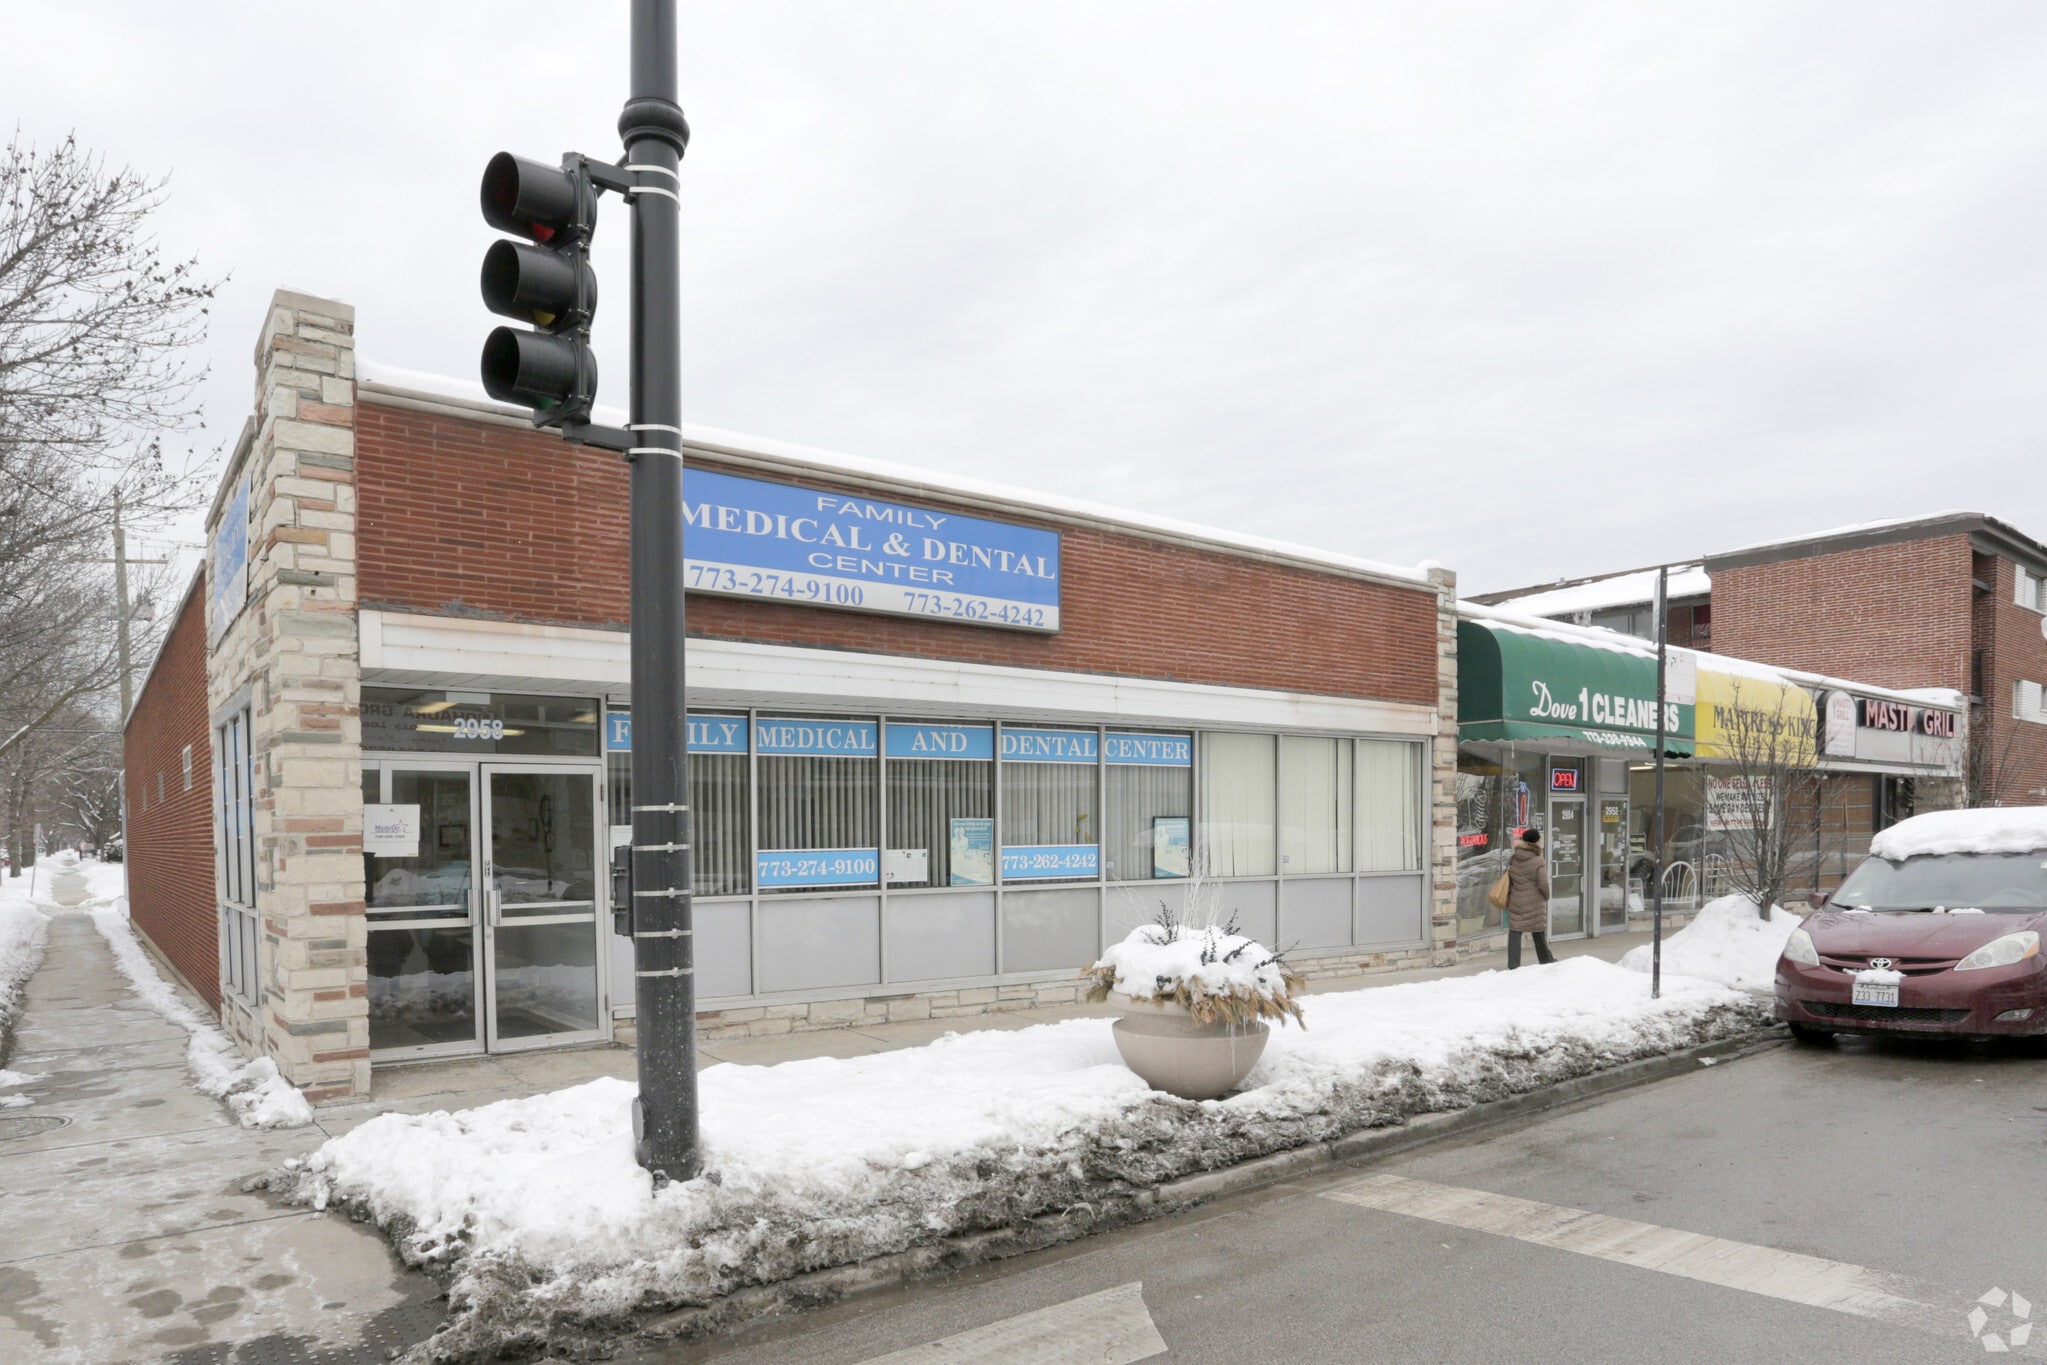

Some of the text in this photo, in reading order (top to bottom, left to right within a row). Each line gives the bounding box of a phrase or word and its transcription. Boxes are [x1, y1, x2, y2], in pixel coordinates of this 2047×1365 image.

[817, 497, 947, 531] FAMILY
[682, 500, 1056, 581] MEDICAL & DENTAL
[808, 552, 955, 586] CENTER
[689, 564, 1044, 627] 773-274-9100 773-262-4242
[1530, 680, 1578, 720] Dove
[1579, 687, 1589, 722] 1
[1866, 698, 1960, 738] MASTI GRILL
[453, 717, 504, 740] 2958
[612, 719, 1189, 761] FILY MEDICAL AND DENTAL CENTER
[1787, 715, 1816, 739] KING
[1553, 772, 1576, 787] OPEN
[758, 853, 1096, 878] 773-274-9100 773-262-4242
